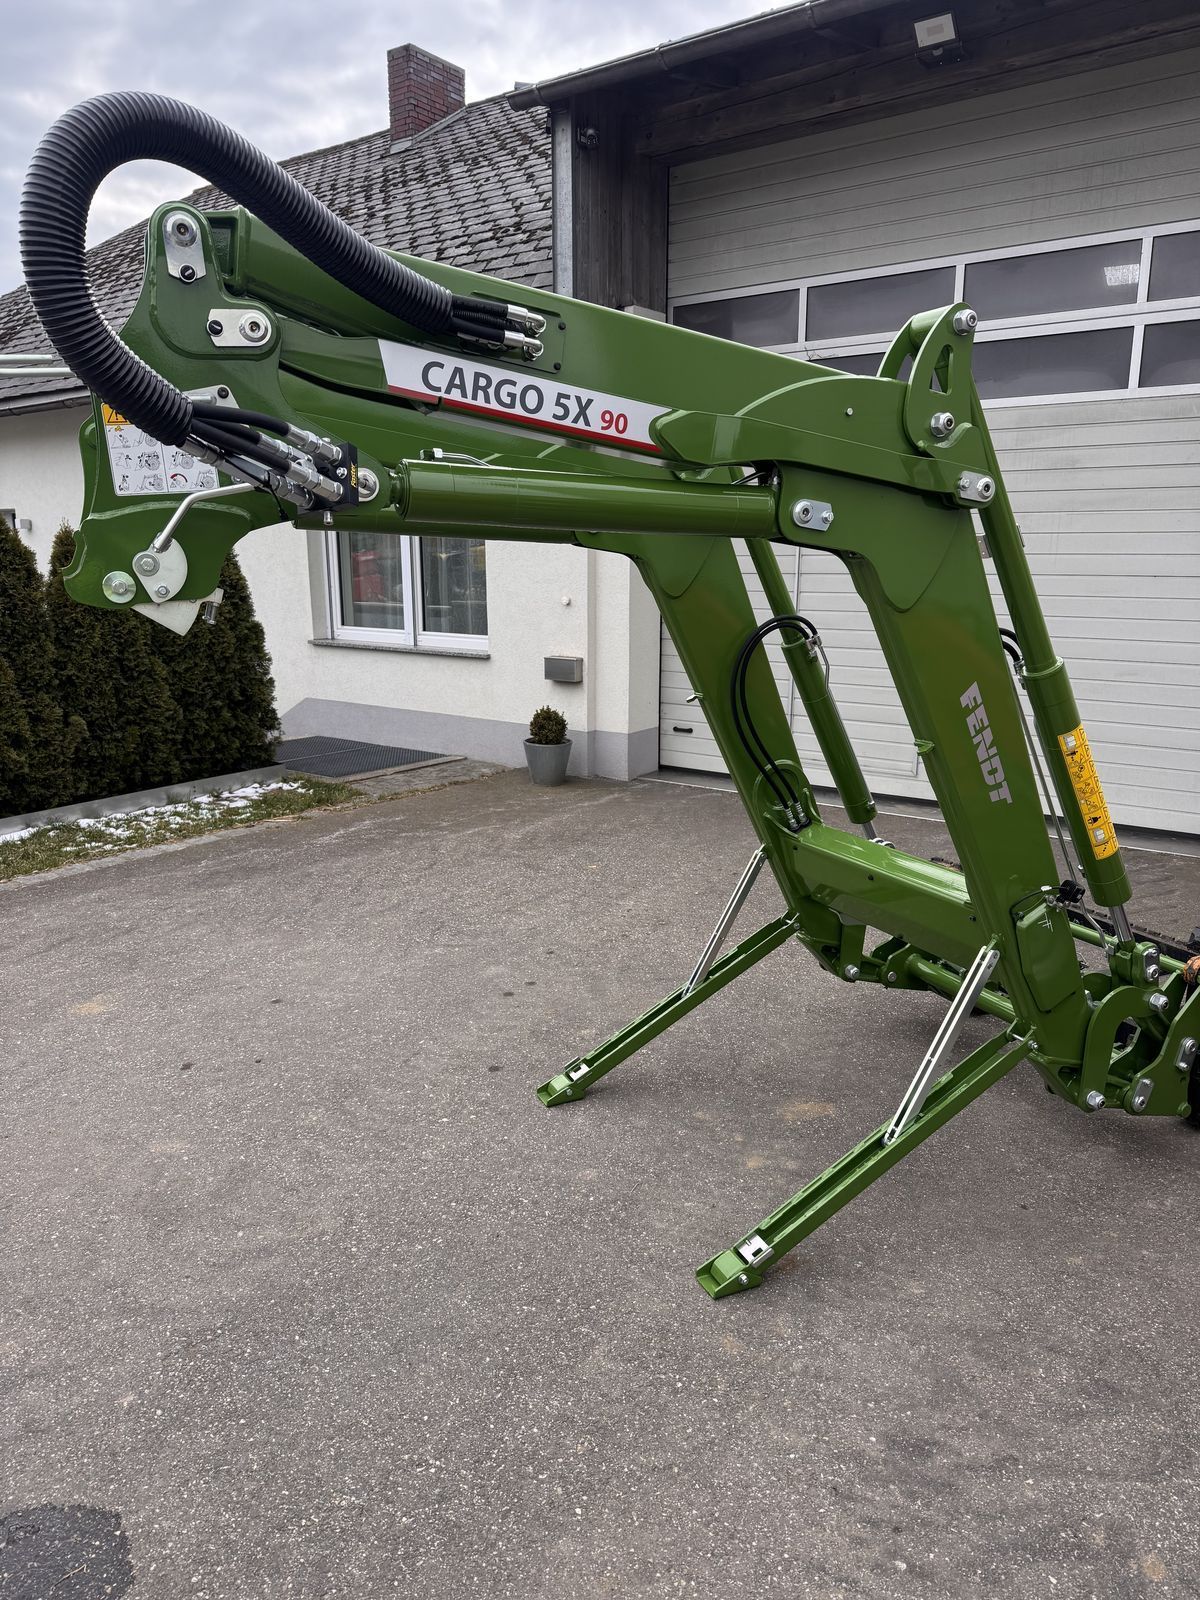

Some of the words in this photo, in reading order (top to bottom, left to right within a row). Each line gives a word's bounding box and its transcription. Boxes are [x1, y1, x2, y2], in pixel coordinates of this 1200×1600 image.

[421, 361, 545, 415] CARGO
[552, 392, 595, 428] 5X
[599, 409, 629, 435] 90
[960, 681, 1013, 804] FENDT
